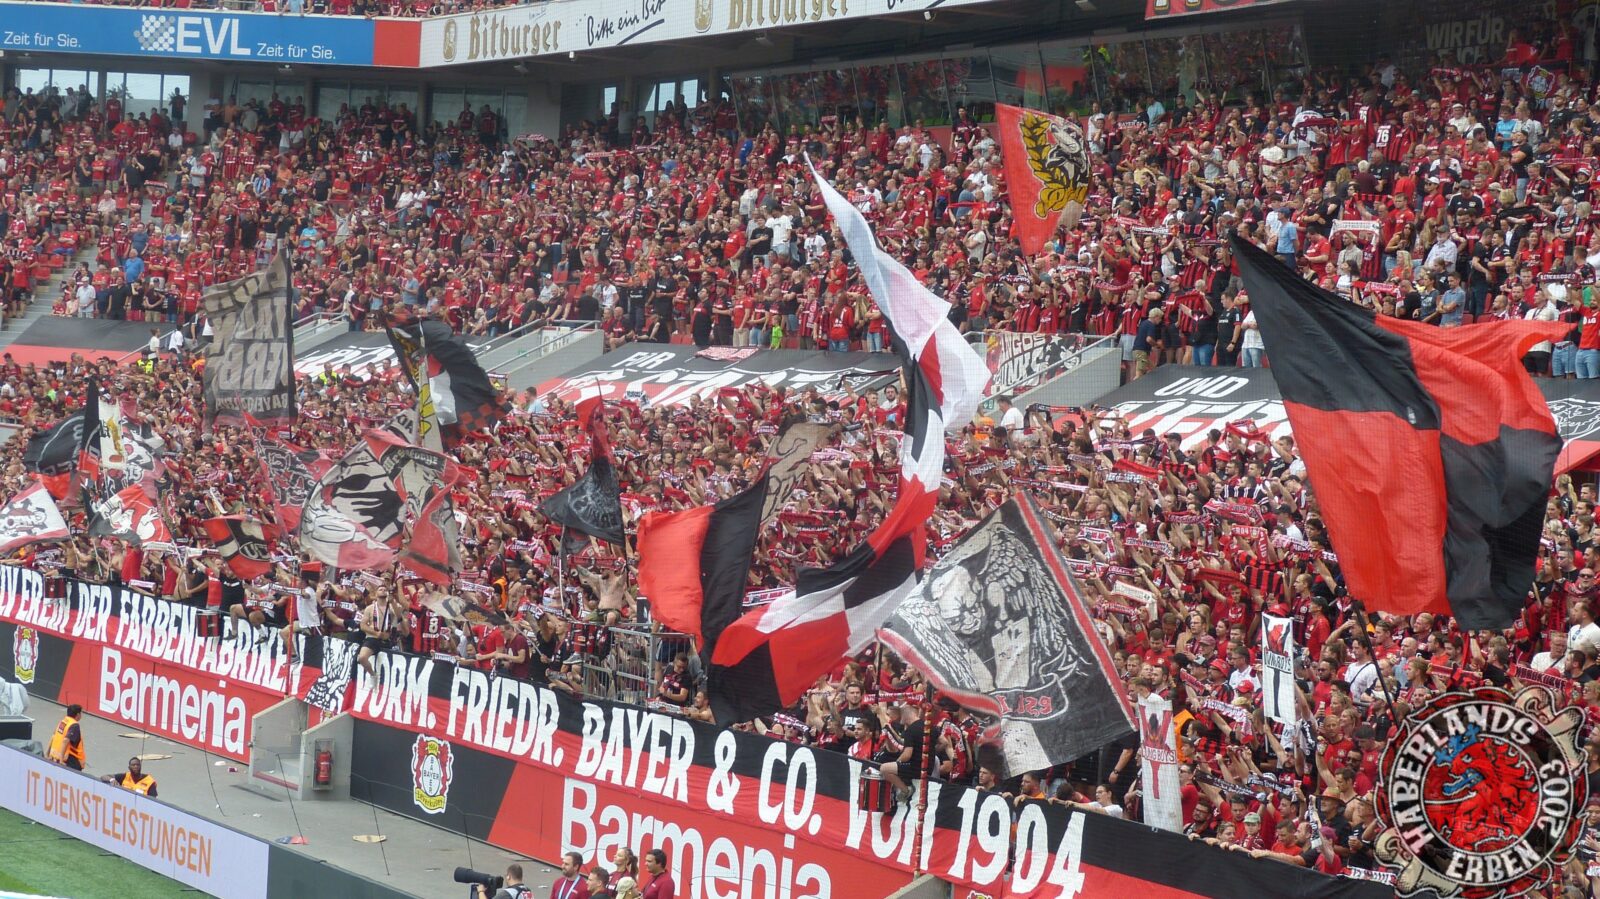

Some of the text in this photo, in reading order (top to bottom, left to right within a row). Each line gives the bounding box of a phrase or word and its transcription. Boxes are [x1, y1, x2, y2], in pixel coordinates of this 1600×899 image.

[3, 31, 82, 48] Zeit für Sie.
[175, 16, 251, 56] EVL
[467, 14, 563, 60] Bitburger
[587, 15, 615, 47] Bitte
[617, 10, 640, 31] ein
[1426, 14, 1504, 50] WIR FÜR
[257, 42, 336, 60] Zeit für Sie.
[1153, 374, 1250, 399] UND
[98, 646, 246, 756] Barmenia
[72, 582, 113, 644] DER
[353, 650, 436, 730] VORM.
[446, 665, 564, 768] FRIEDR.
[574, 701, 696, 804] BAYER
[705, 729, 741, 815] &
[757, 744, 823, 837] CO.
[845, 757, 943, 871] VON
[947, 786, 1087, 899] 1904
[25, 768, 213, 878] IT DIENSTLEISTUNGEN
[561, 776, 832, 899] Barmenia
